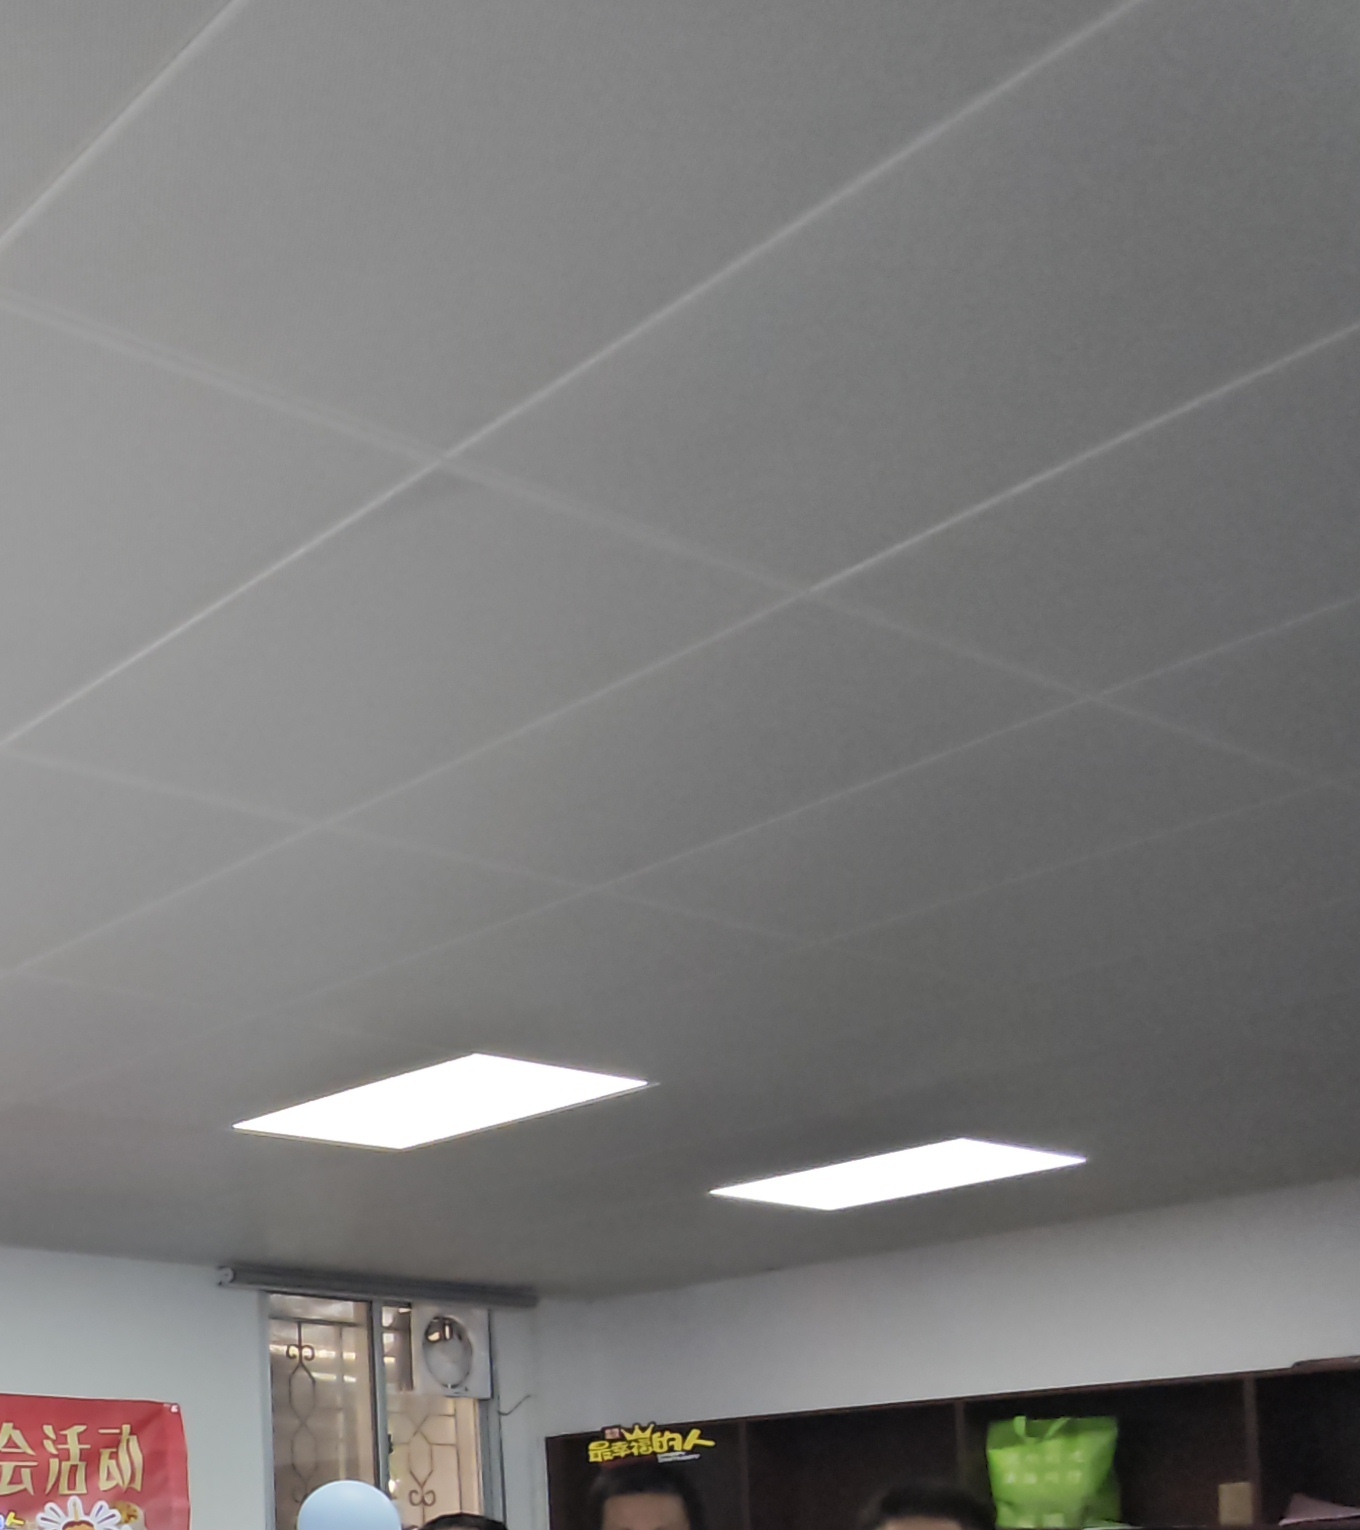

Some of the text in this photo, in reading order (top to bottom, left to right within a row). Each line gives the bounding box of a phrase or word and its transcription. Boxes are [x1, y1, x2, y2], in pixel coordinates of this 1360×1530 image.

[587, 1427, 716, 1463] 最幸福的人
